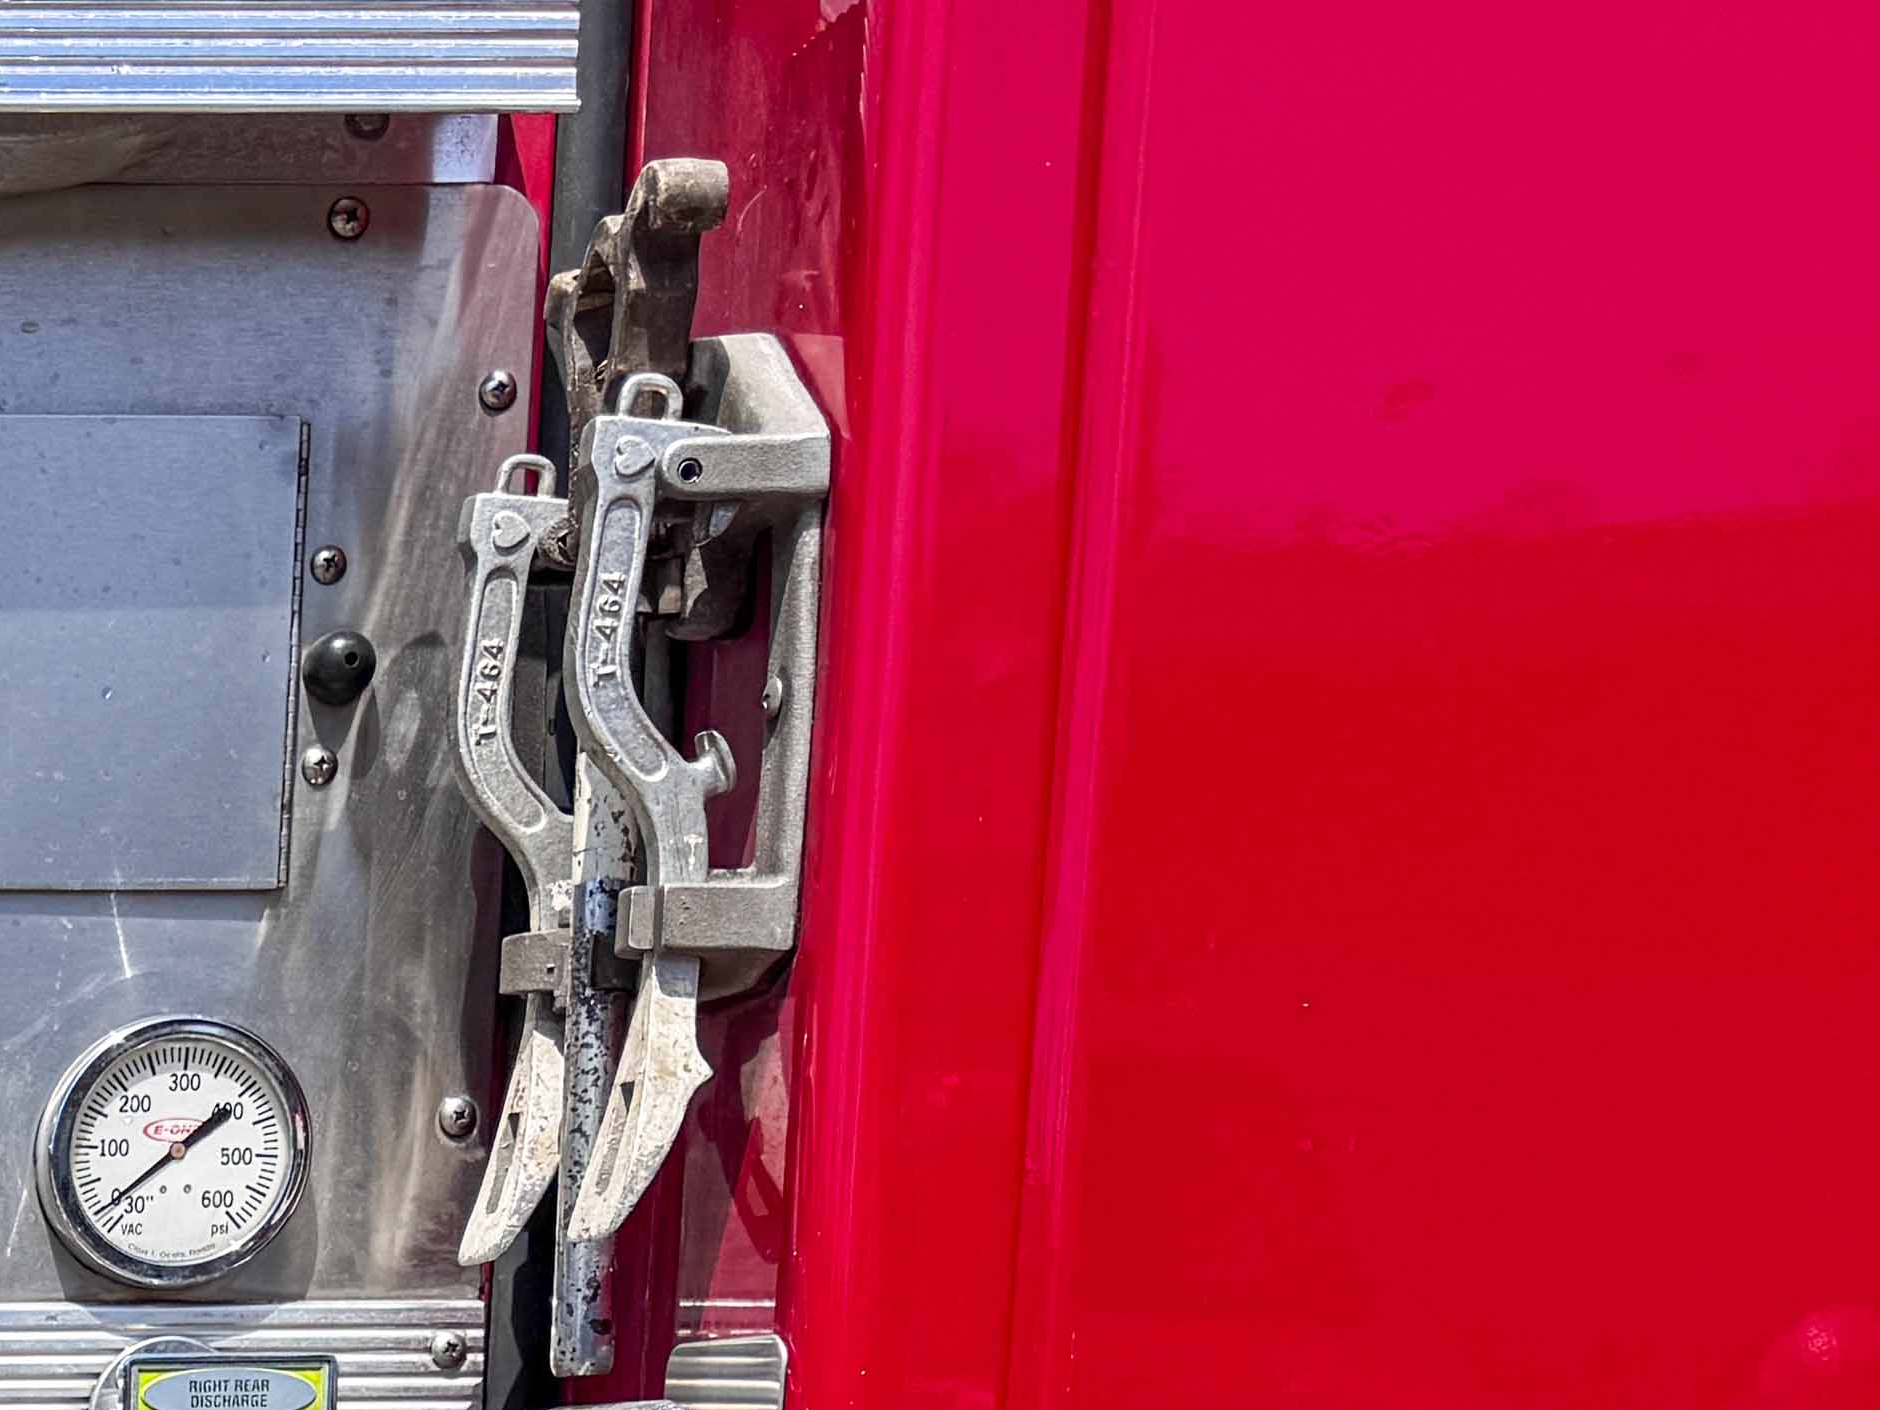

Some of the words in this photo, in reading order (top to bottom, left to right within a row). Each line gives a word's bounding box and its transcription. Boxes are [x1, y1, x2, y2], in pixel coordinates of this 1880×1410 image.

[589, 571, 626, 688] T-464
[471, 638, 504, 746] T-464
[168, 1072, 202, 1092] 300
[220, 1147, 253, 1166] 500
[189, 1379, 231, 1393] RIGHT
[235, 1379, 271, 1393] REAR
[190, 1394, 268, 1408] DISCHARGE
